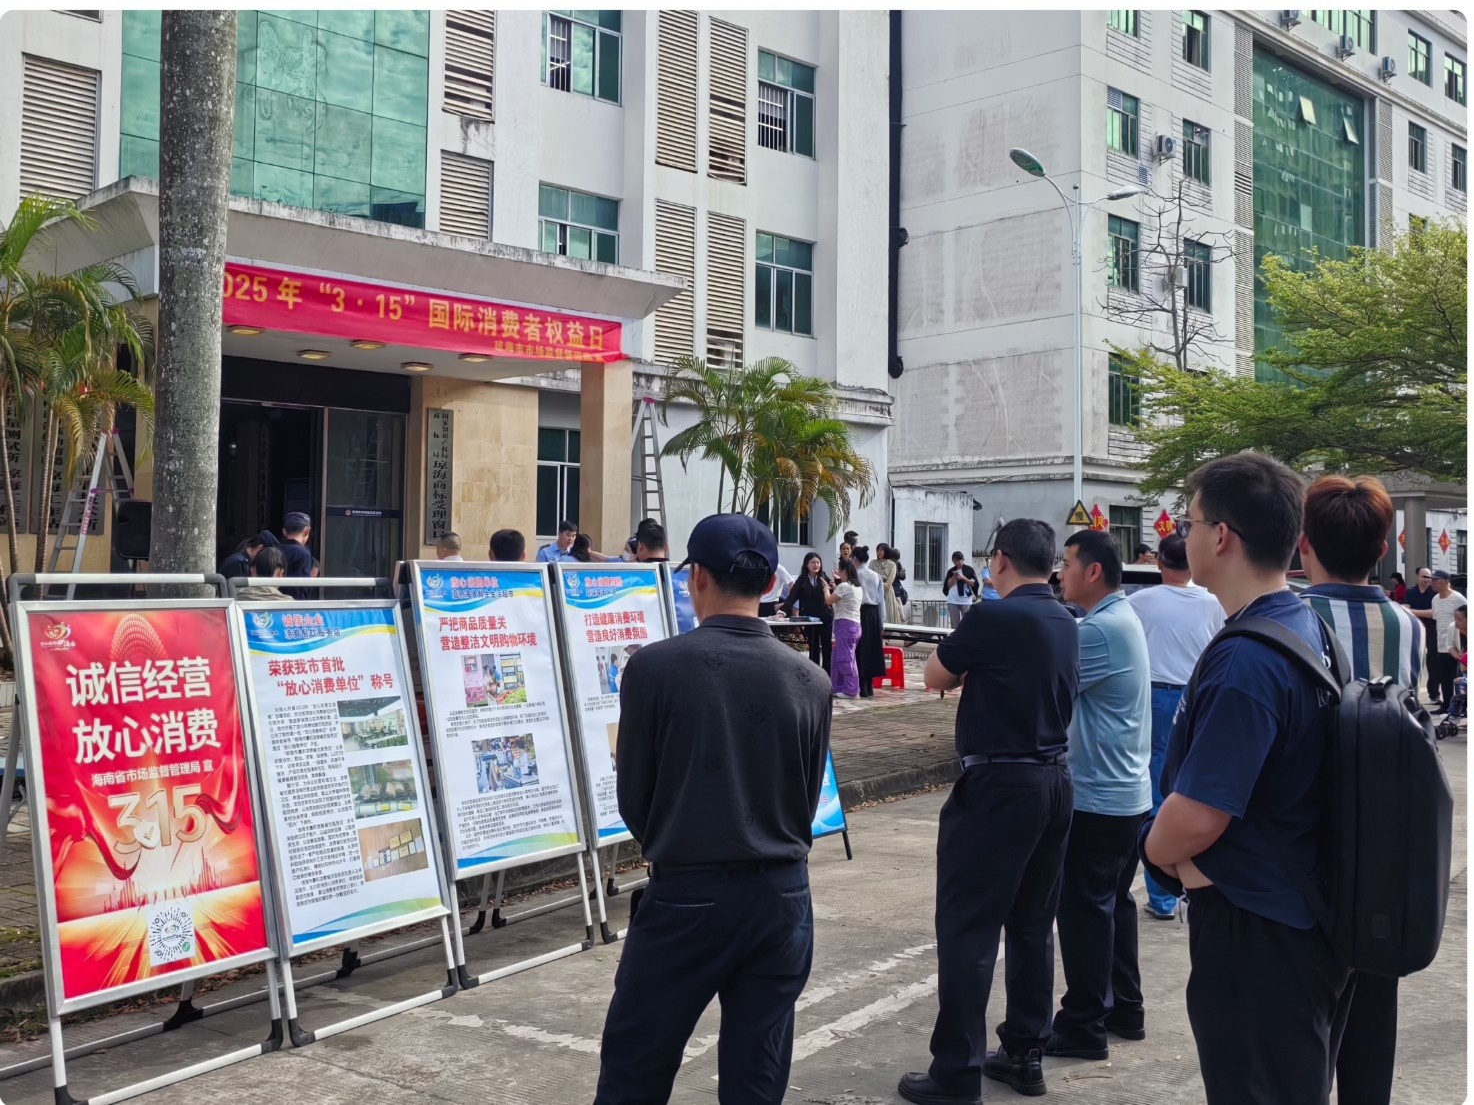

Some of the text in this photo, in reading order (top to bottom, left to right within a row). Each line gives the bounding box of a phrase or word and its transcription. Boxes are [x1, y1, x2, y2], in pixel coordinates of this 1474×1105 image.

[428, 298, 604, 351] 国际消费者权益日
[438, 615, 507, 632] 严把商品质量关
[440, 632, 538, 651] 营造整洁文明购物环境
[267, 656, 346, 677] 荣获我市首批
[65, 655, 212, 707] 诚信经营
[72, 707, 222, 765] 放心消费
[91, 760, 201, 787] 海南省市场监督管理局
